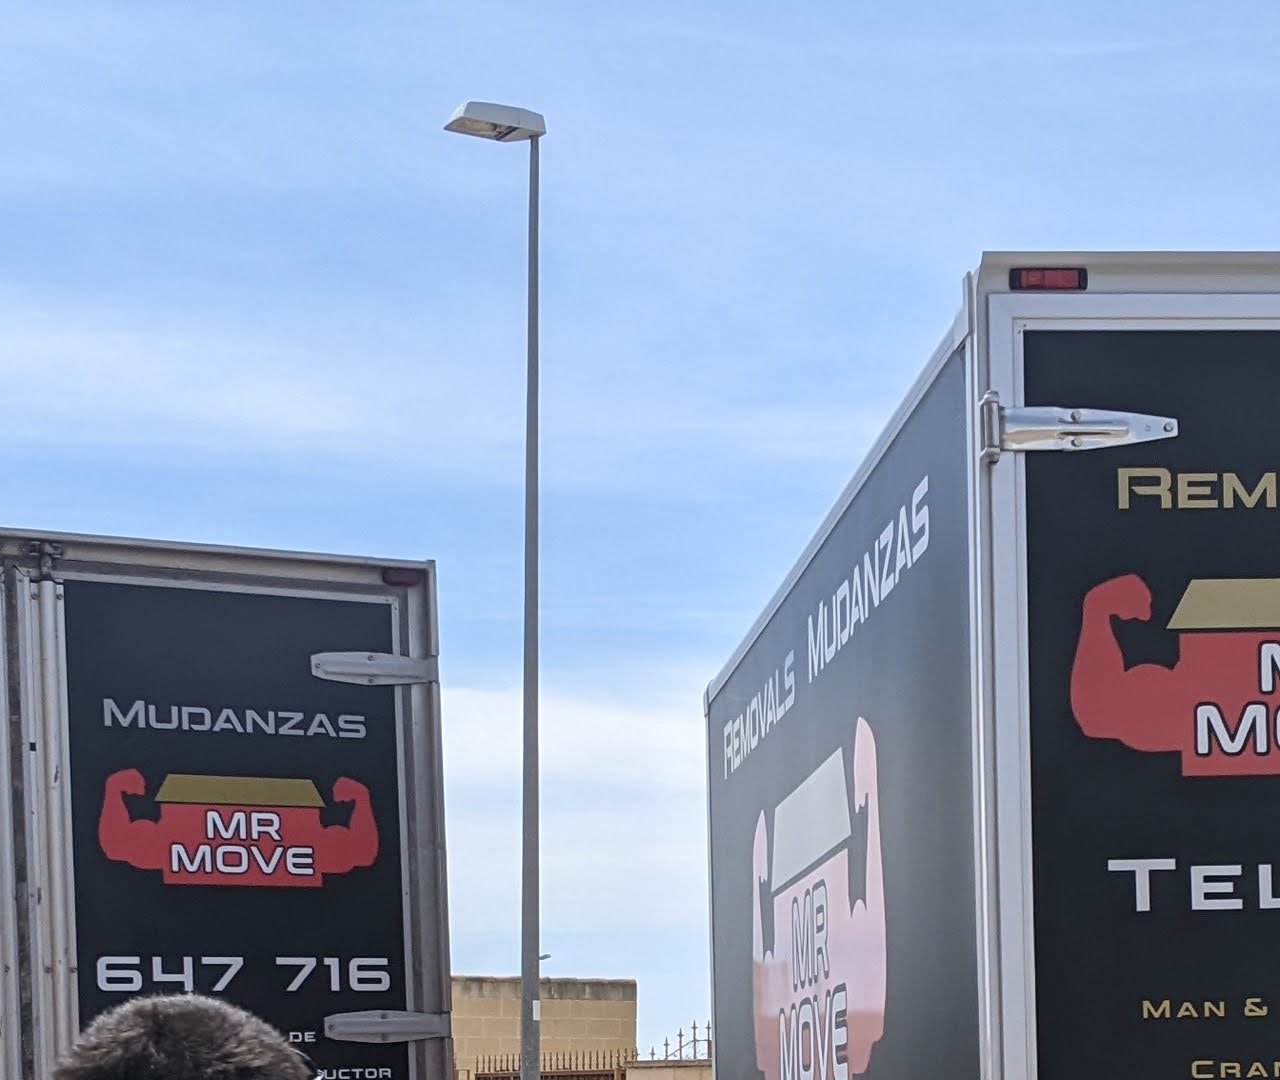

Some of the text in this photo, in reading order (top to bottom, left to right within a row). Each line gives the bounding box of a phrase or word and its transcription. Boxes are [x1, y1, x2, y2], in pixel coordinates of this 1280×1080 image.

[723, 475, 930, 780] REMOVALS MUDANZAS
[104, 699, 367, 740] MUDANZAS
[206, 811, 282, 842] MR
[170, 844, 314, 876] MOVE
[792, 880, 830, 990] MR
[97, 956, 244, 992] 647
[275, 956, 391, 992] 716
[1142, 1000, 1225, 1019] MAN
[1244, 998, 1268, 1016] &
[289, 1031, 316, 1043] DE
[323, 1067, 392, 1080] UCTOR
